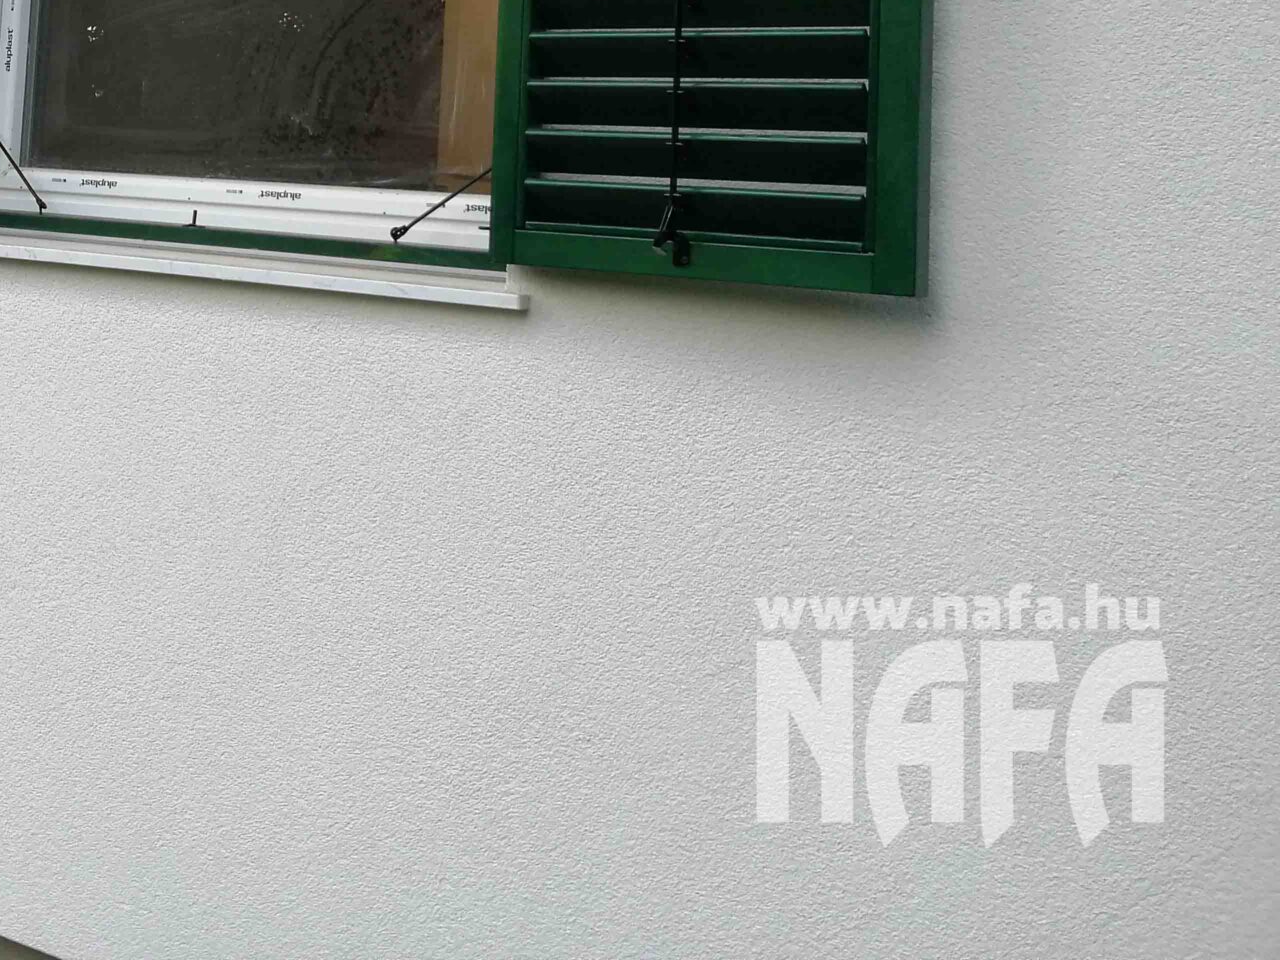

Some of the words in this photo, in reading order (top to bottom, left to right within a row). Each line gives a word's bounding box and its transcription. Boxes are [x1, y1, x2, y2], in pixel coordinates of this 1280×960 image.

[5, 27, 14, 72] aluplast
[80, 178, 118, 189] aluplast
[259, 189, 302, 201] aluplast
